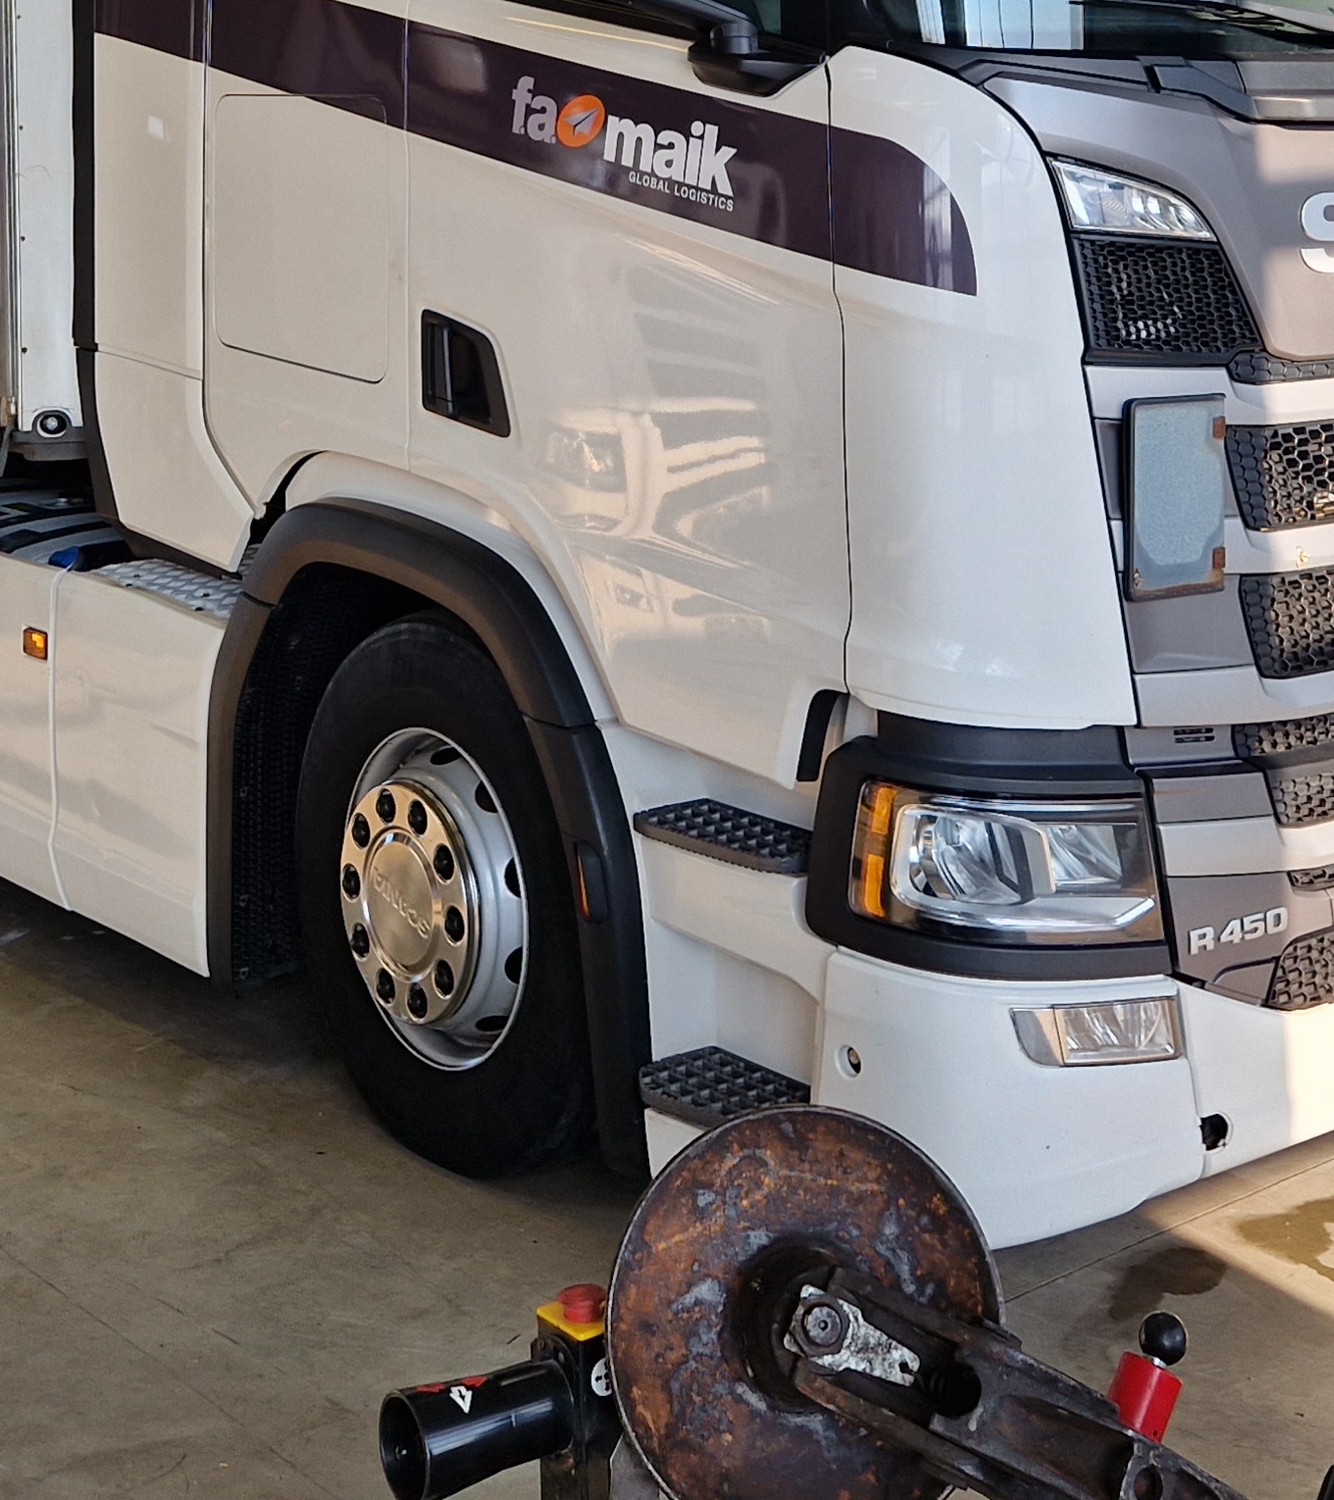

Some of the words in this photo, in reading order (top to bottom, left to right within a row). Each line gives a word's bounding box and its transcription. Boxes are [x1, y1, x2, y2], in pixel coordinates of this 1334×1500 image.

[603, 113, 738, 197] maik
[628, 171, 671, 194] GLOBAL
[674, 185, 735, 212] LOGISTICS
[1189, 926, 1215, 955] R
[1219, 905, 1290, 947] 450
